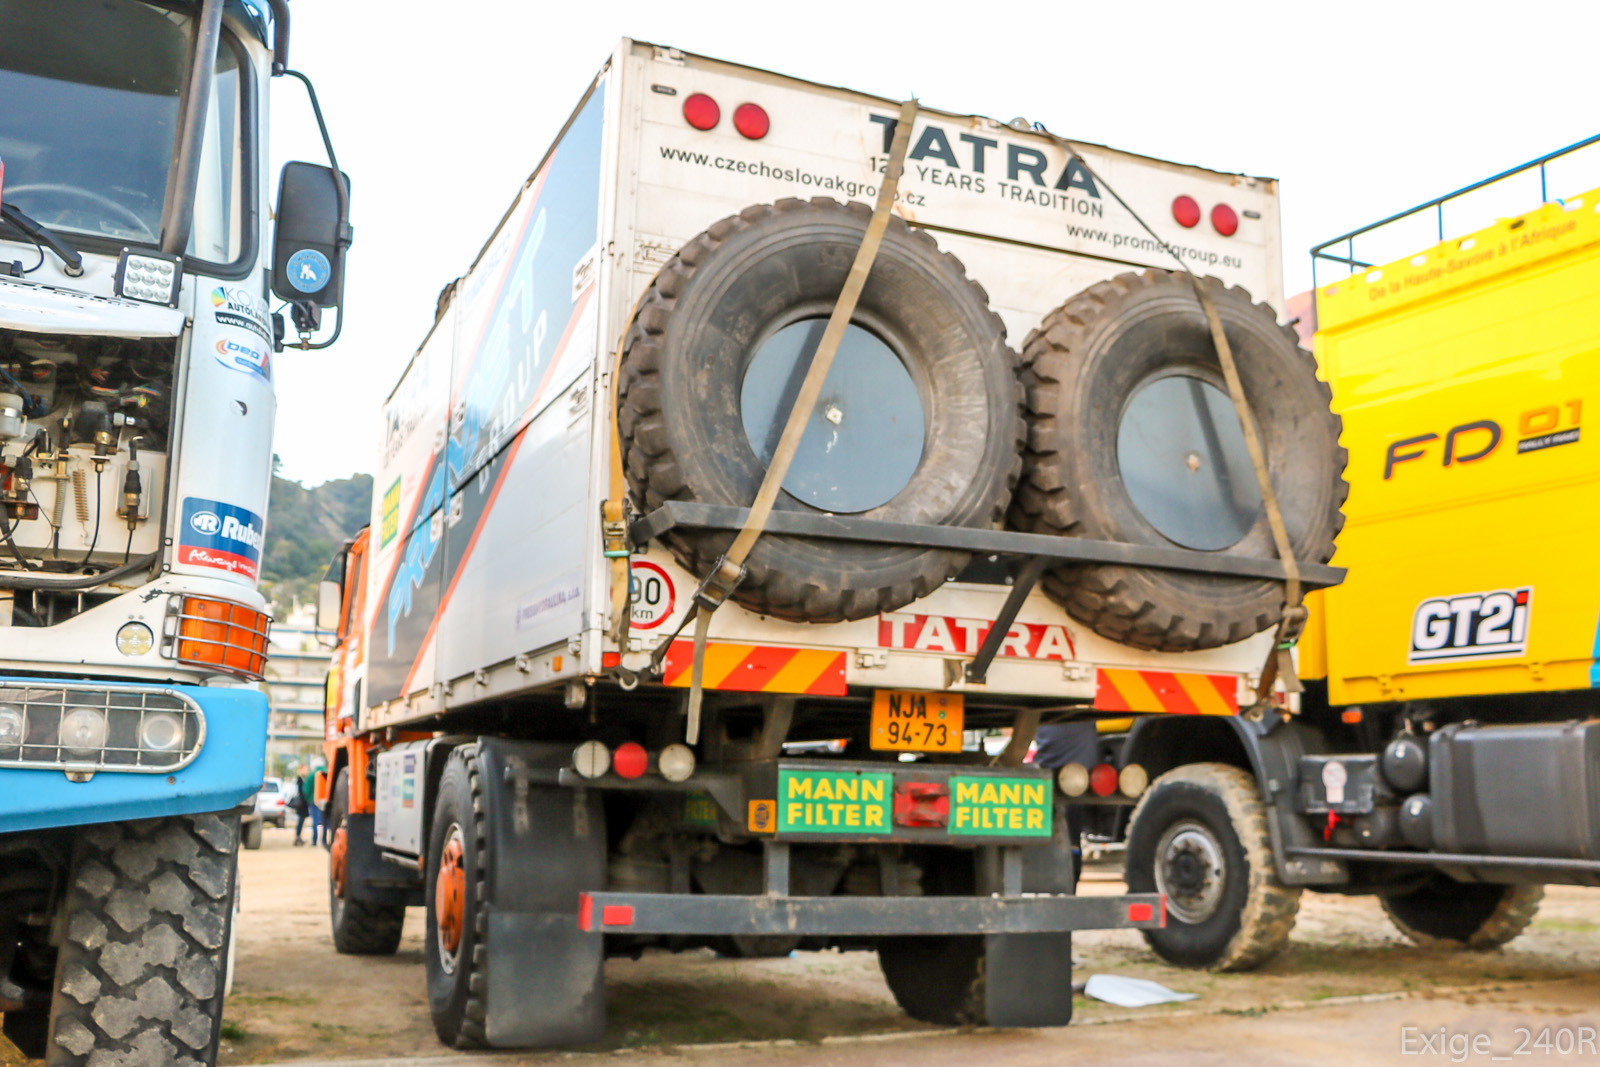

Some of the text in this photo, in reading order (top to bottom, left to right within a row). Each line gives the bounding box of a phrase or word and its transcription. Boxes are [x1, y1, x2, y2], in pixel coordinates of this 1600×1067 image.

[868, 113, 1102, 200] TATRA
[916, 165, 986, 194] YEARS
[997, 182, 1103, 219] TRADITION
[1066, 223, 1242, 269] www.prometgroup.eu
[1384, 398, 1582, 481] FD 01
[632, 605, 654, 620] km
[1413, 589, 1529, 651] GT2i
[881, 612, 1075, 661] TATRA
[888, 694, 927, 720] NJA
[888, 721, 948, 747] 94-73
[787, 776, 885, 801] MANN
[955, 782, 1045, 806] MANN
[786, 802, 884, 826] FILTER
[955, 807, 1044, 829] FILTER
